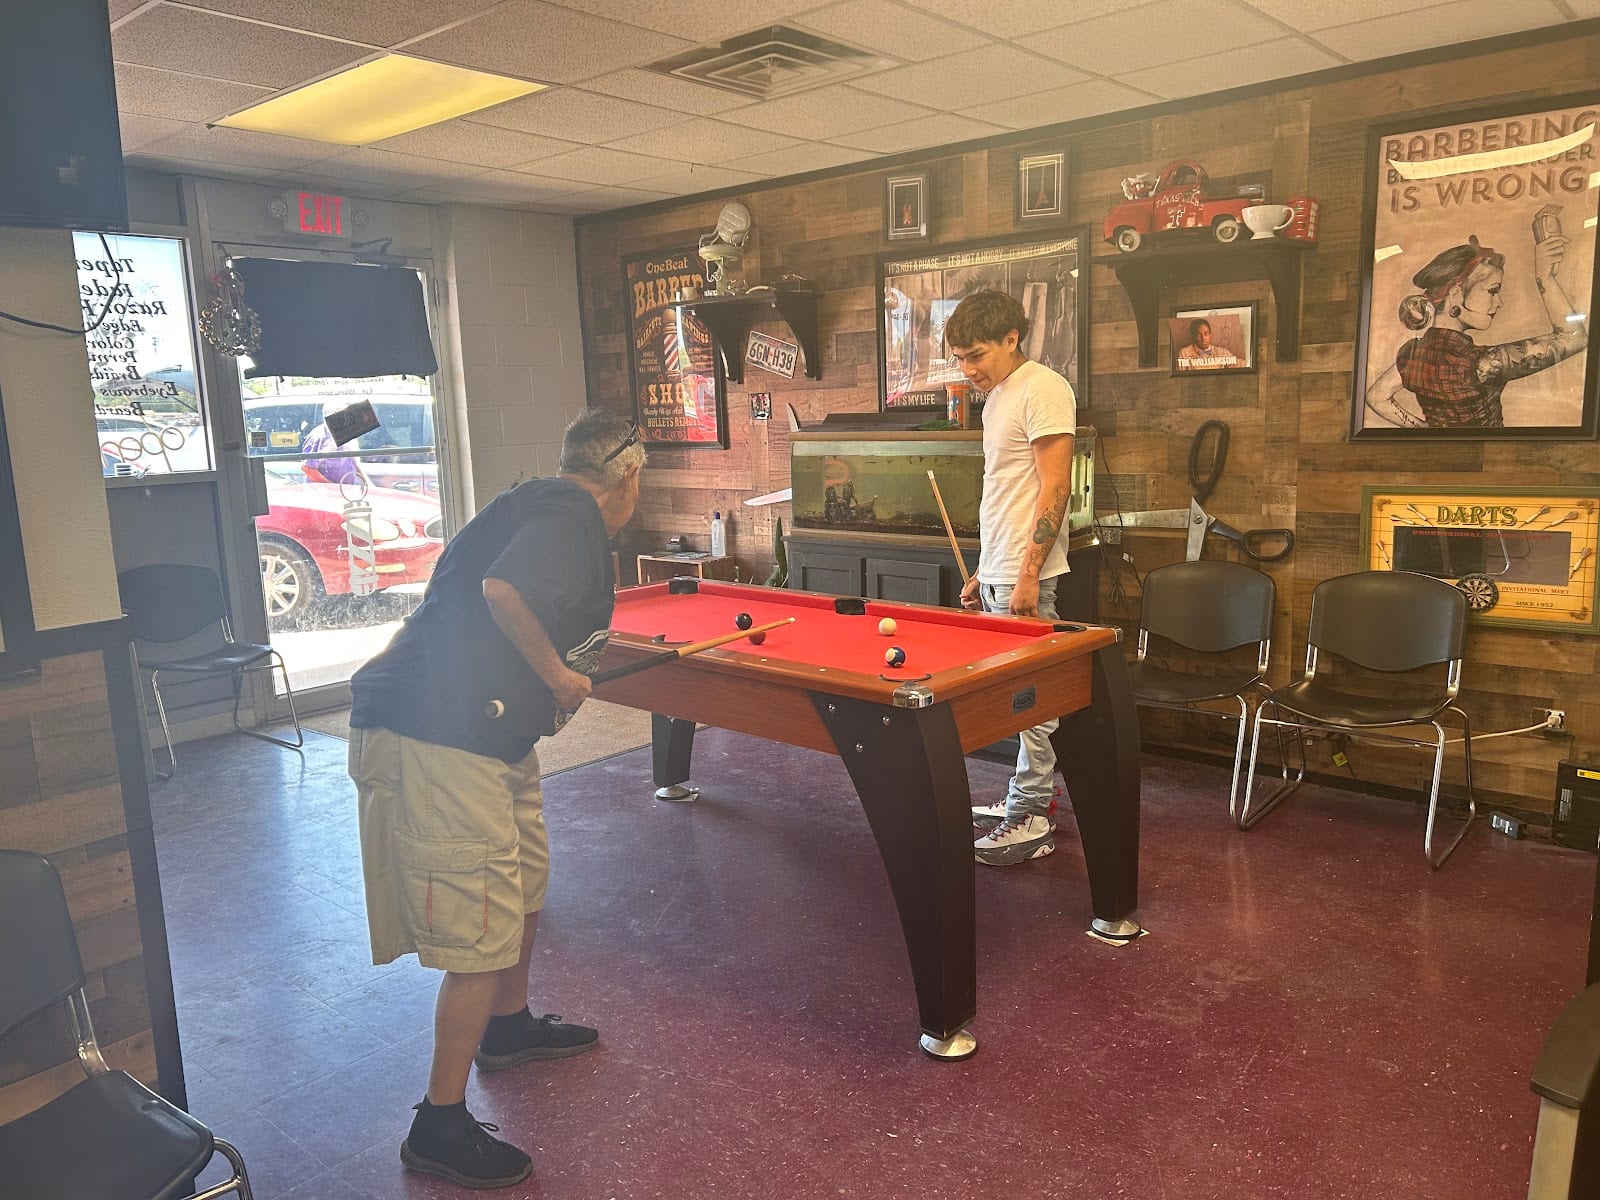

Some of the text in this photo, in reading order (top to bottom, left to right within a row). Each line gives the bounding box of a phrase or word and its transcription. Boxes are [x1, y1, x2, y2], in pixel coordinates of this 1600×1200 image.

[1390, 165, 1589, 214] IS WRONG
[298, 192, 344, 235] EXIT
[888, 263, 900, 275] IT'S
[900, 262, 913, 273] NOT
[918, 258, 940, 271] PHASE
[907, 394, 920, 406] MY
[919, 393, 936, 406] LIFE
[1436, 505, 1518, 527] DARTS
[1500, 585, 1548, 594] INVITATIONAL
[1514, 600, 1535, 608] SINCE
